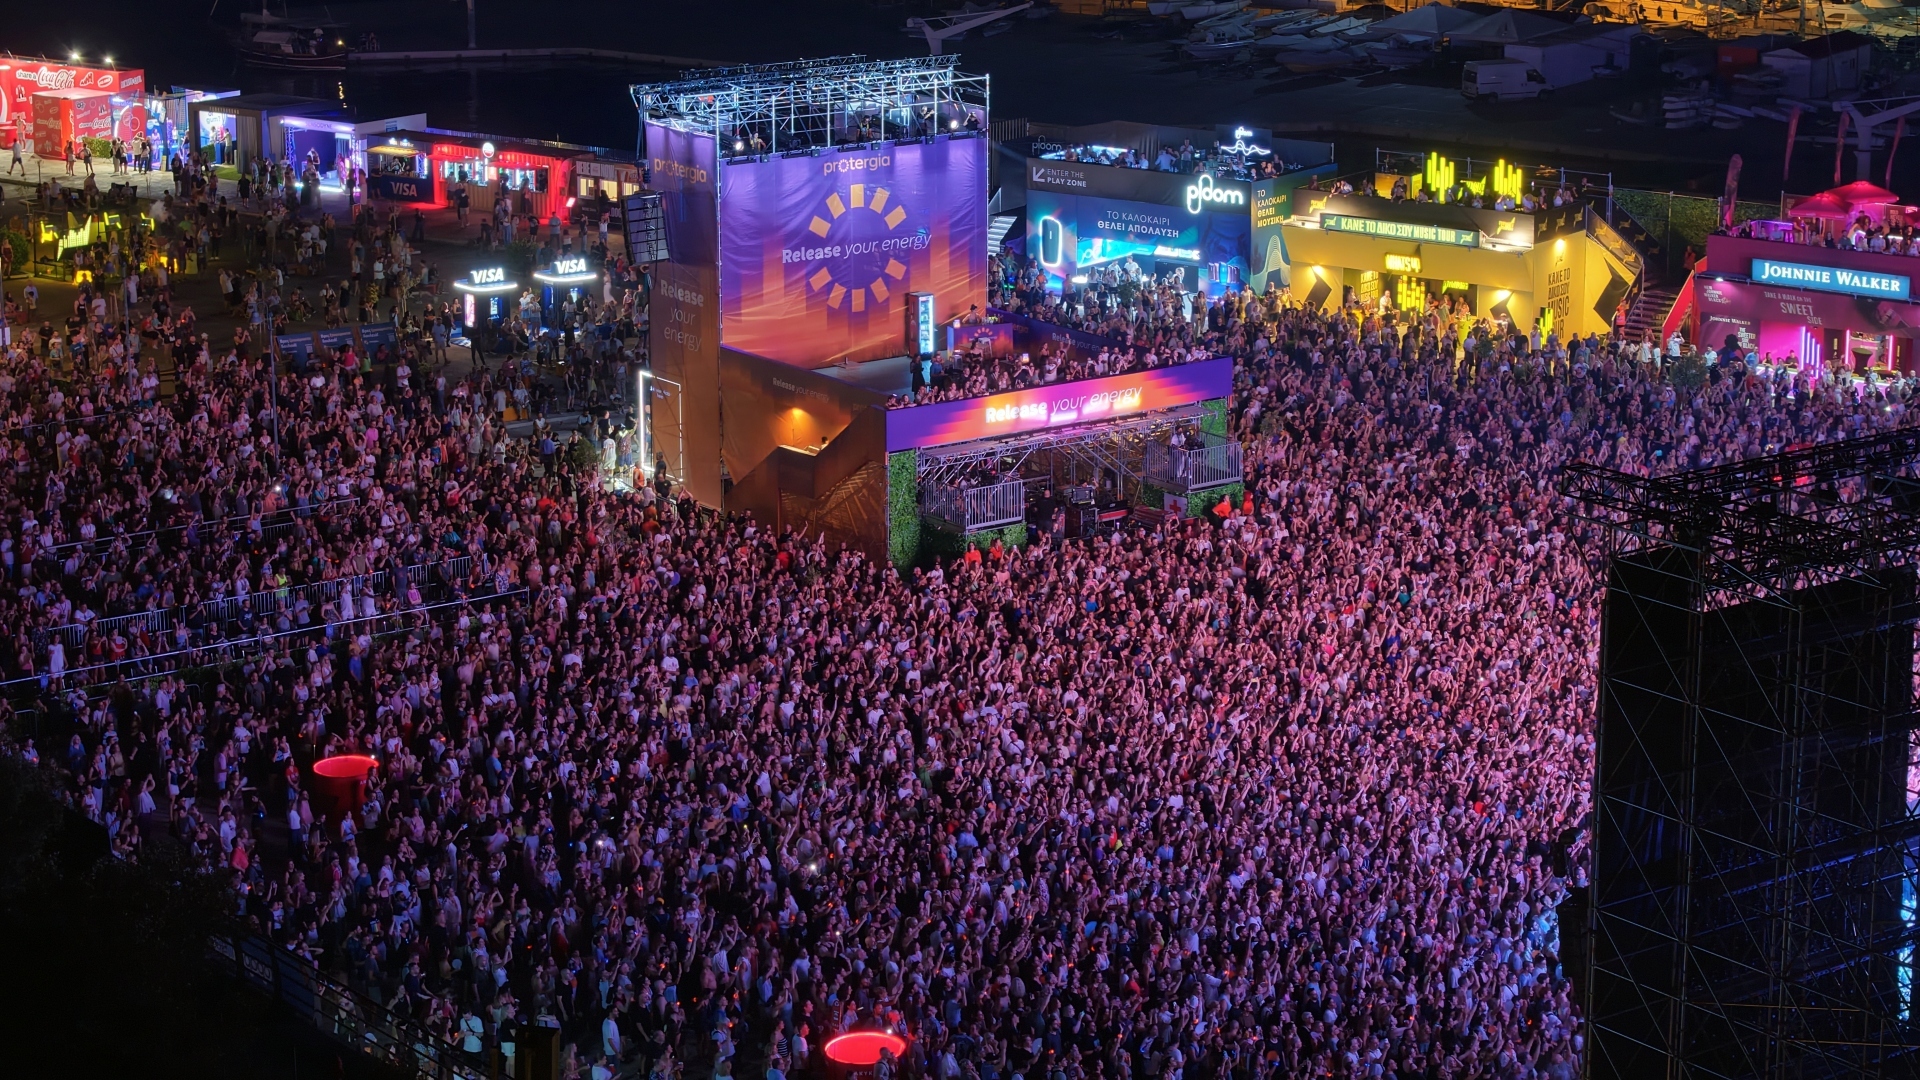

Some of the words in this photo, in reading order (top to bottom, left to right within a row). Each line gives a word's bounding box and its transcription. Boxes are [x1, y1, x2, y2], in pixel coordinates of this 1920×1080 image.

[1032, 135, 1062, 156] ploom
[654, 158, 706, 185] protergia
[824, 154, 891, 176] protergia
[1047, 168, 1069, 177] ENTER
[1071, 170, 1084, 179] THE
[390, 182, 418, 197] VISA
[1047, 177, 1065, 185] PLAY
[1067, 180, 1087, 188] ZONE
[1187, 174, 1243, 214] ploom
[1257, 194, 1287, 208] ΚΑΛΟΚΑΙΡΙ
[1106, 210, 1120, 220] ΤΟ
[1121, 212, 1171, 226] ΚΑΛΟΚΑΙΡΙ
[1257, 206, 1275, 218] ΘΕΛΕΙ
[1097, 220, 1125, 232] ΘΕΛΕΙ
[1126, 223, 1179, 238] ΑΠΟΛΑΥΣΗ
[1341, 217, 1365, 232] ΚΑΝΕ
[1365, 220, 1376, 233] ΤΟ
[1376, 221, 1397, 236] ΔΙΚΟ
[1397, 224, 1413, 237] ΣΟΥ
[1413, 225, 1437, 241] MUSIC
[1437, 228, 1456, 243] TOUR
[782, 245, 842, 263] Release
[844, 239, 878, 259] your
[881, 234, 932, 253] energy
[554, 258, 586, 275] VISA
[470, 267, 504, 284] VISA
[660, 279, 705, 307] Release
[1764, 291, 1777, 299] TAKE
[669, 305, 696, 327] your
[1779, 302, 1814, 317] SWEET
[1806, 315, 1823, 326] SIDE
[663, 325, 703, 353] energy
[772, 377, 796, 392] Release
[985, 400, 1048, 424] Release
[1050, 393, 1087, 414] your
[1089, 386, 1142, 408] energy
